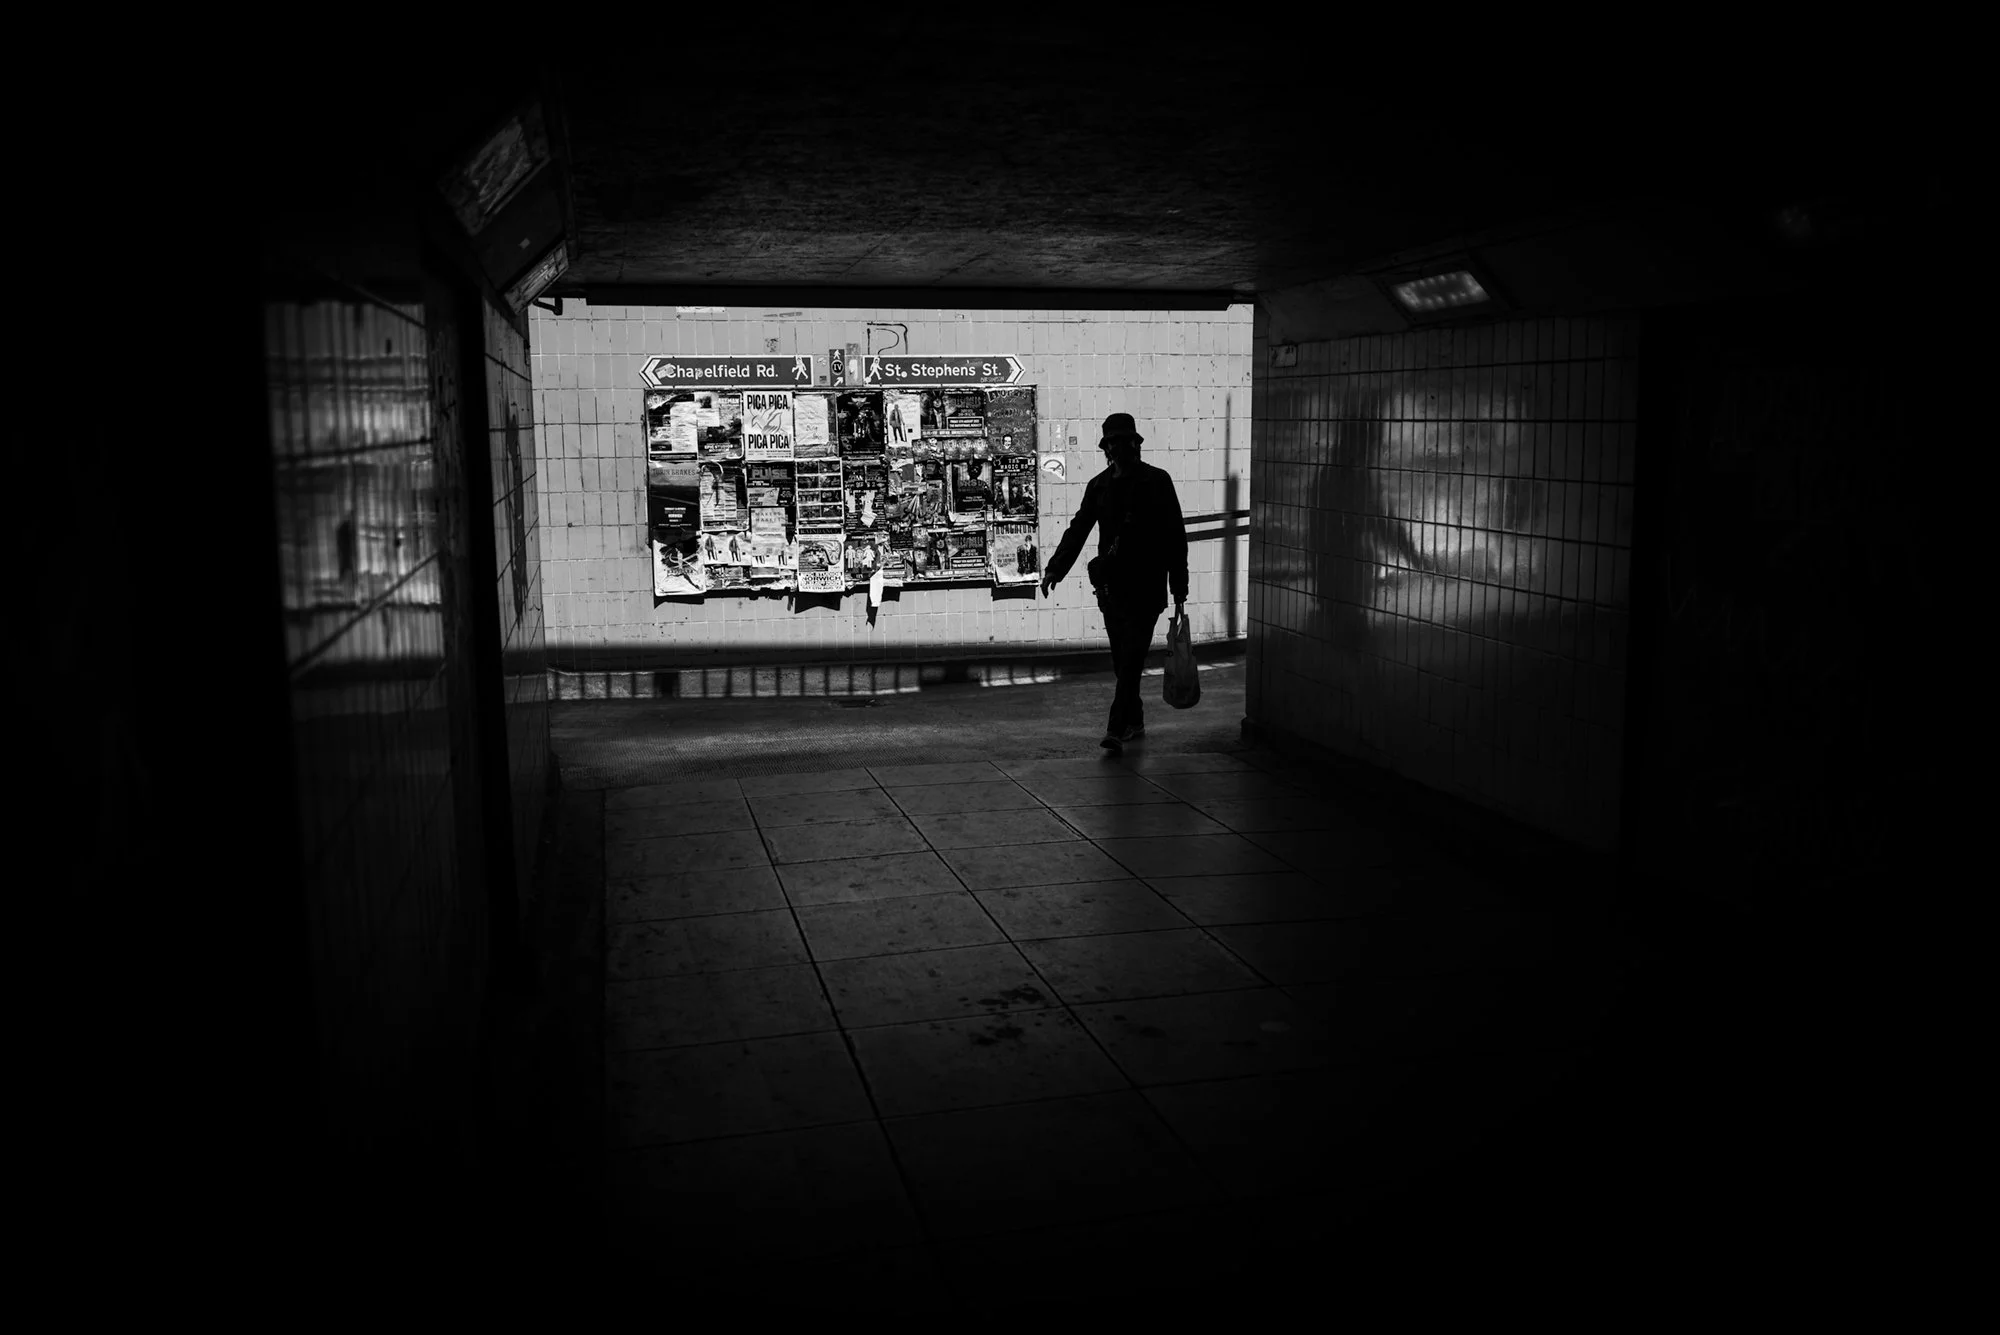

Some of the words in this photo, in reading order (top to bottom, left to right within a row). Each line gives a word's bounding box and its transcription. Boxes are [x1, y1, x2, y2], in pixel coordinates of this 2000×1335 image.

[666, 364, 751, 380] Chapelfield
[756, 364, 779, 378] Rd.
[982, 363, 1002, 376] St.
[747, 394, 767, 410] PICA
[768, 394, 789, 410] PICA
[748, 434, 768, 449] PICA
[770, 434, 790, 449] PICA
[752, 467, 788, 479] PULSE
